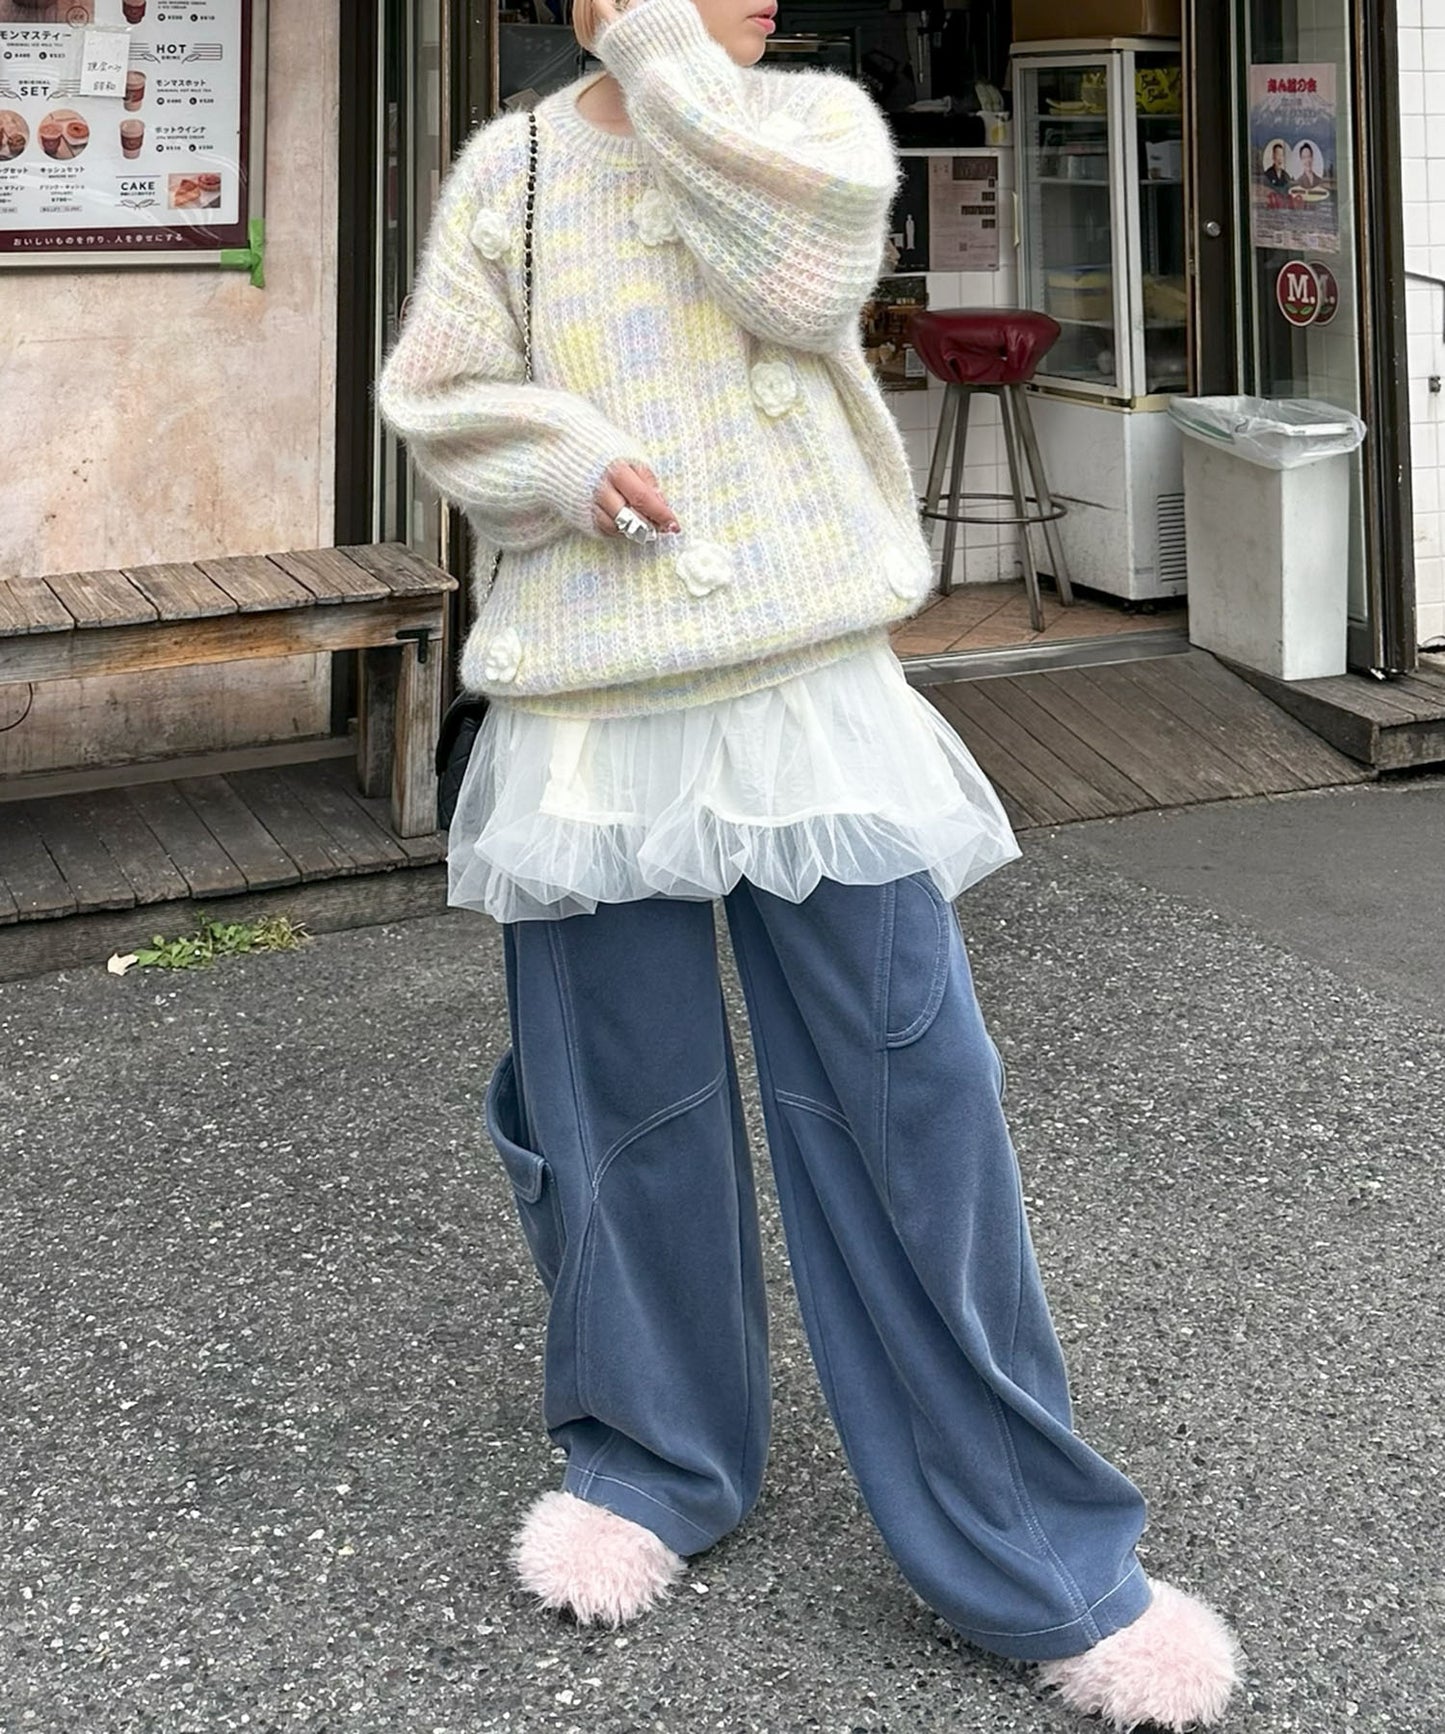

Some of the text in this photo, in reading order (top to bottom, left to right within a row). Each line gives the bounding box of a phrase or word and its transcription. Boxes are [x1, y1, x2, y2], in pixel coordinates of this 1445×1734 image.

[0, 30, 71, 40] モンマスティー
[156, 44, 187, 54] HOT
[20, 86, 49, 96] SET
[120, 181, 156, 191] CAKE
